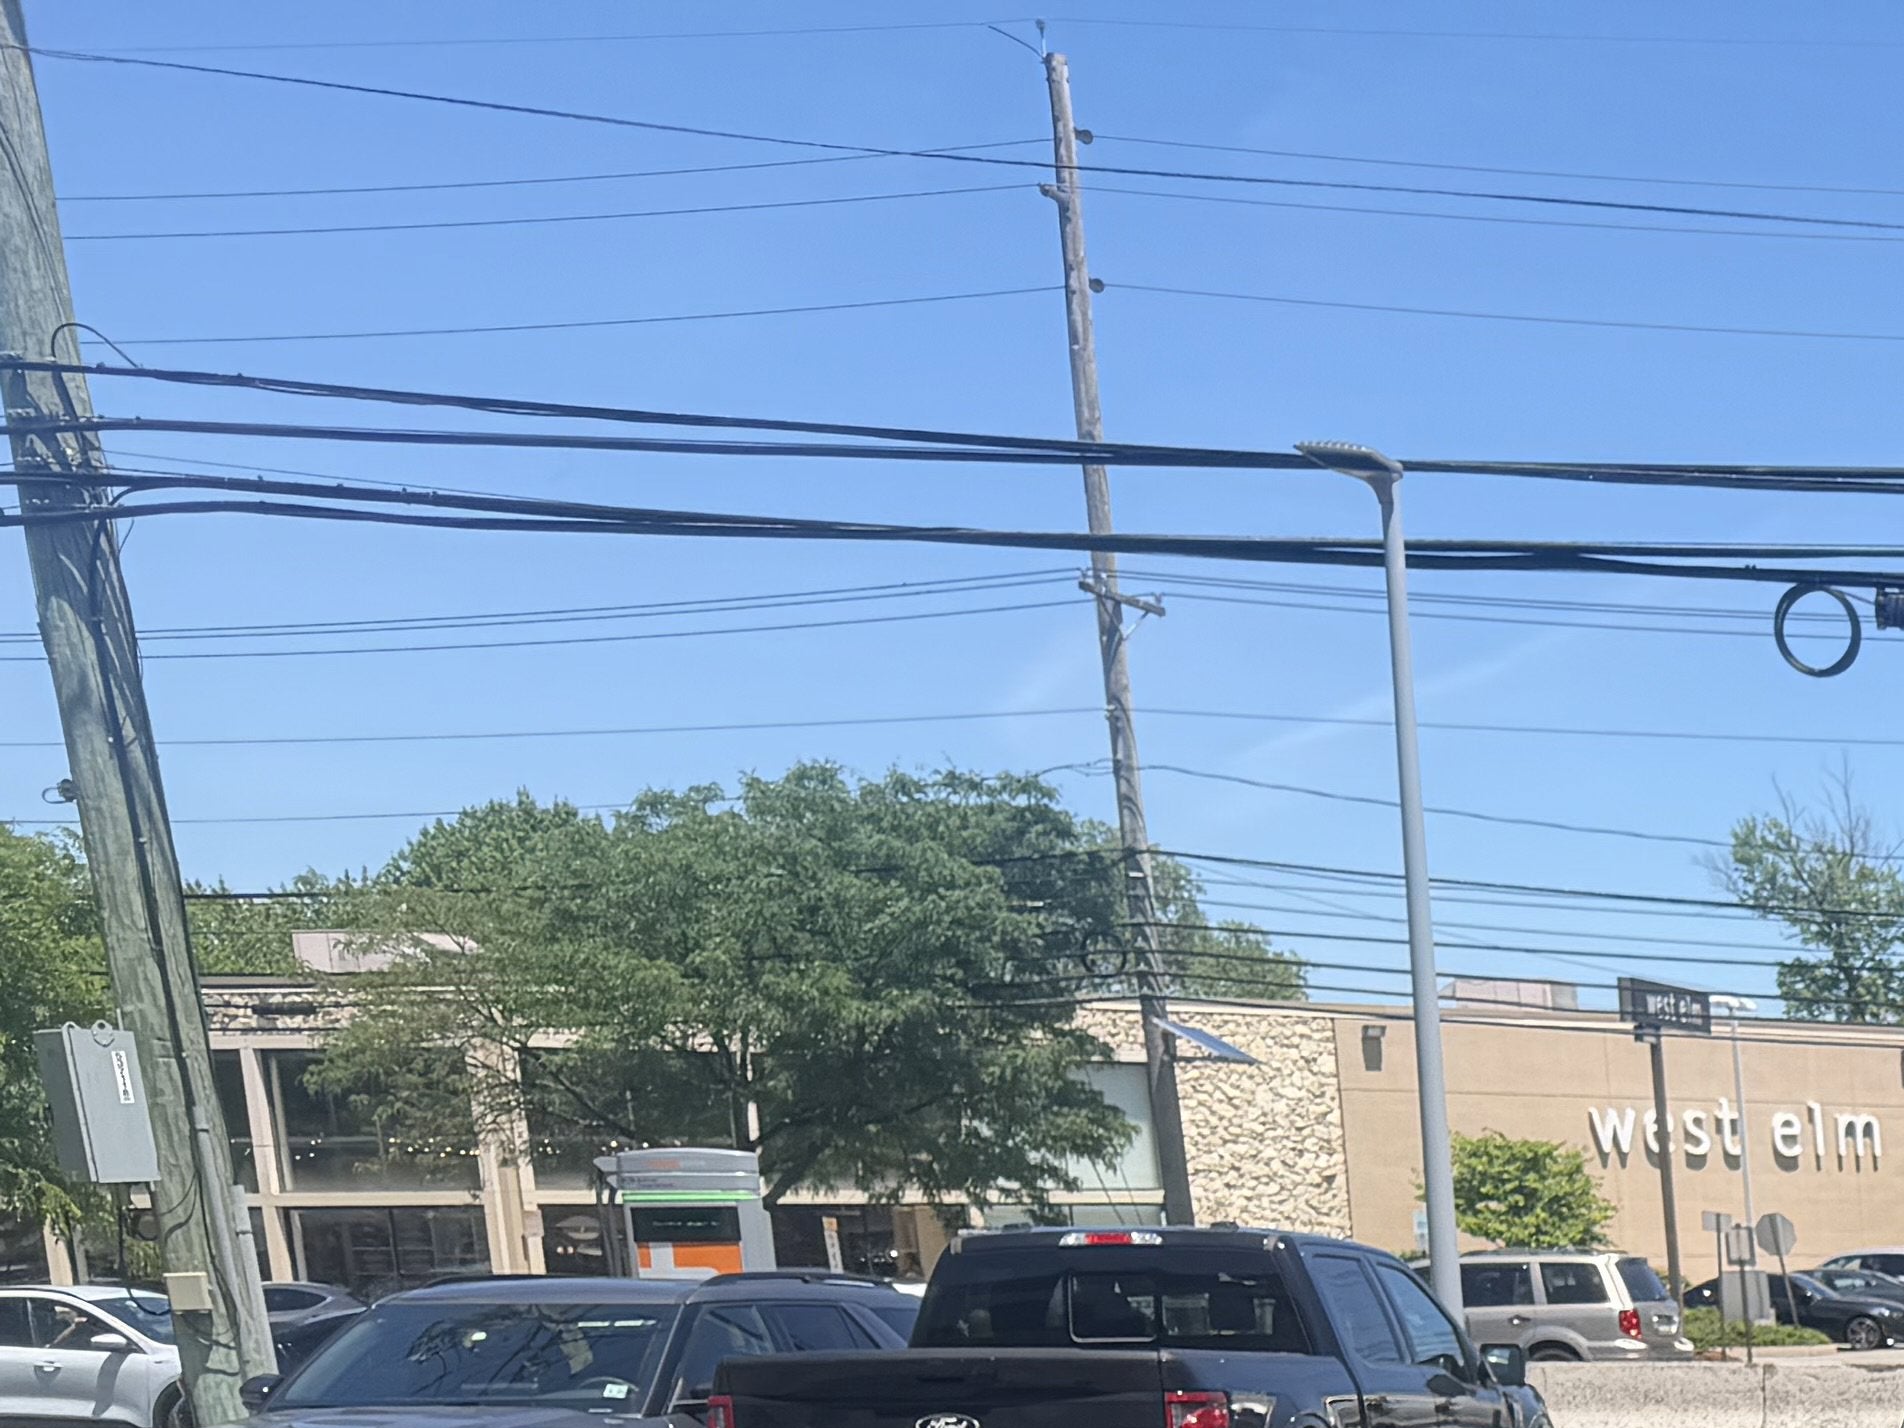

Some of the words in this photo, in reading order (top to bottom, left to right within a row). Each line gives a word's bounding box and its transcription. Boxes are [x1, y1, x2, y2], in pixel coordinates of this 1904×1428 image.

[1645, 992, 1677, 1021] west
[1679, 994, 1703, 1026] elm
[1588, 1096, 1741, 1157] west
[1771, 1100, 1882, 1158] elm
